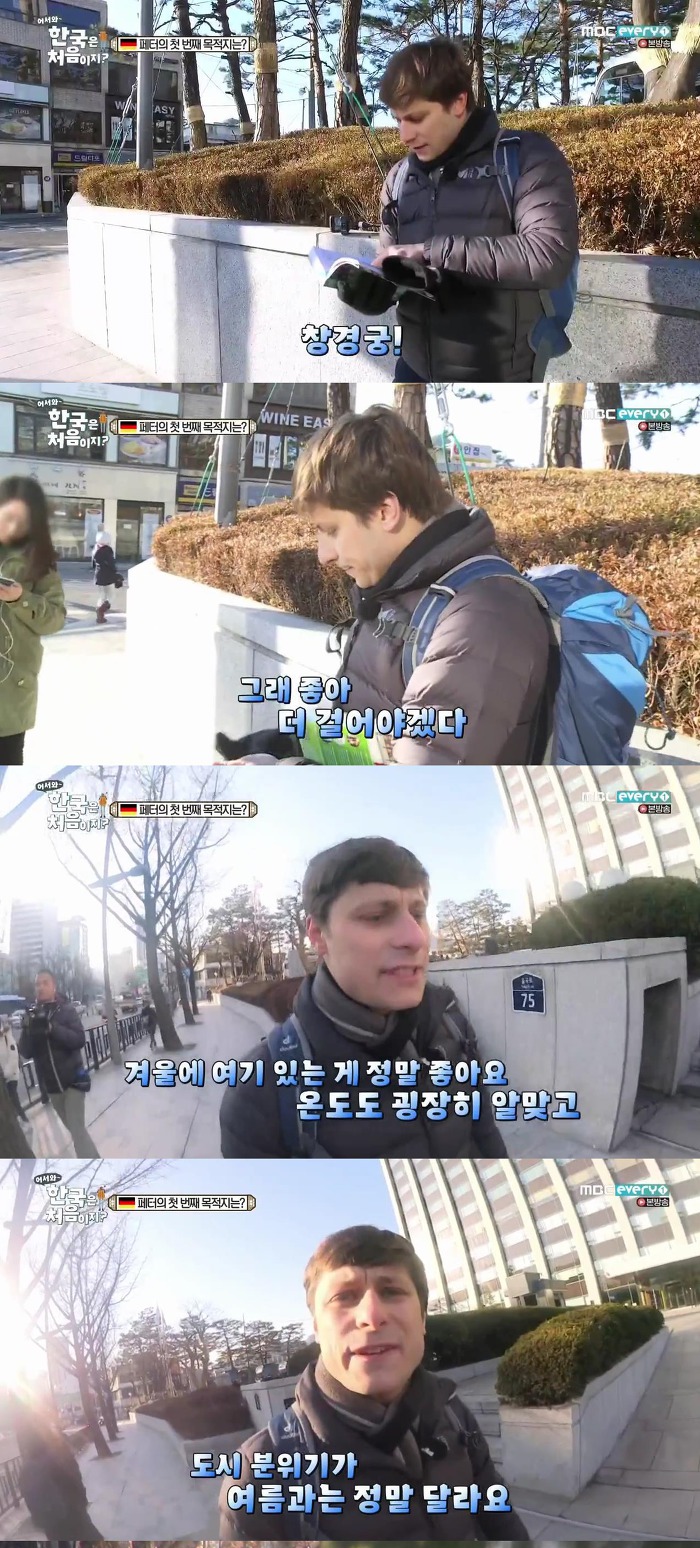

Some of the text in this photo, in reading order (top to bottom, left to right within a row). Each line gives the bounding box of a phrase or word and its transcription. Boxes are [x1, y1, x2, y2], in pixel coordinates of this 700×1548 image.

[152, 105, 175, 115] ASY
[261, 411, 299, 427] WINE
[520, 993, 535, 1008] 75
